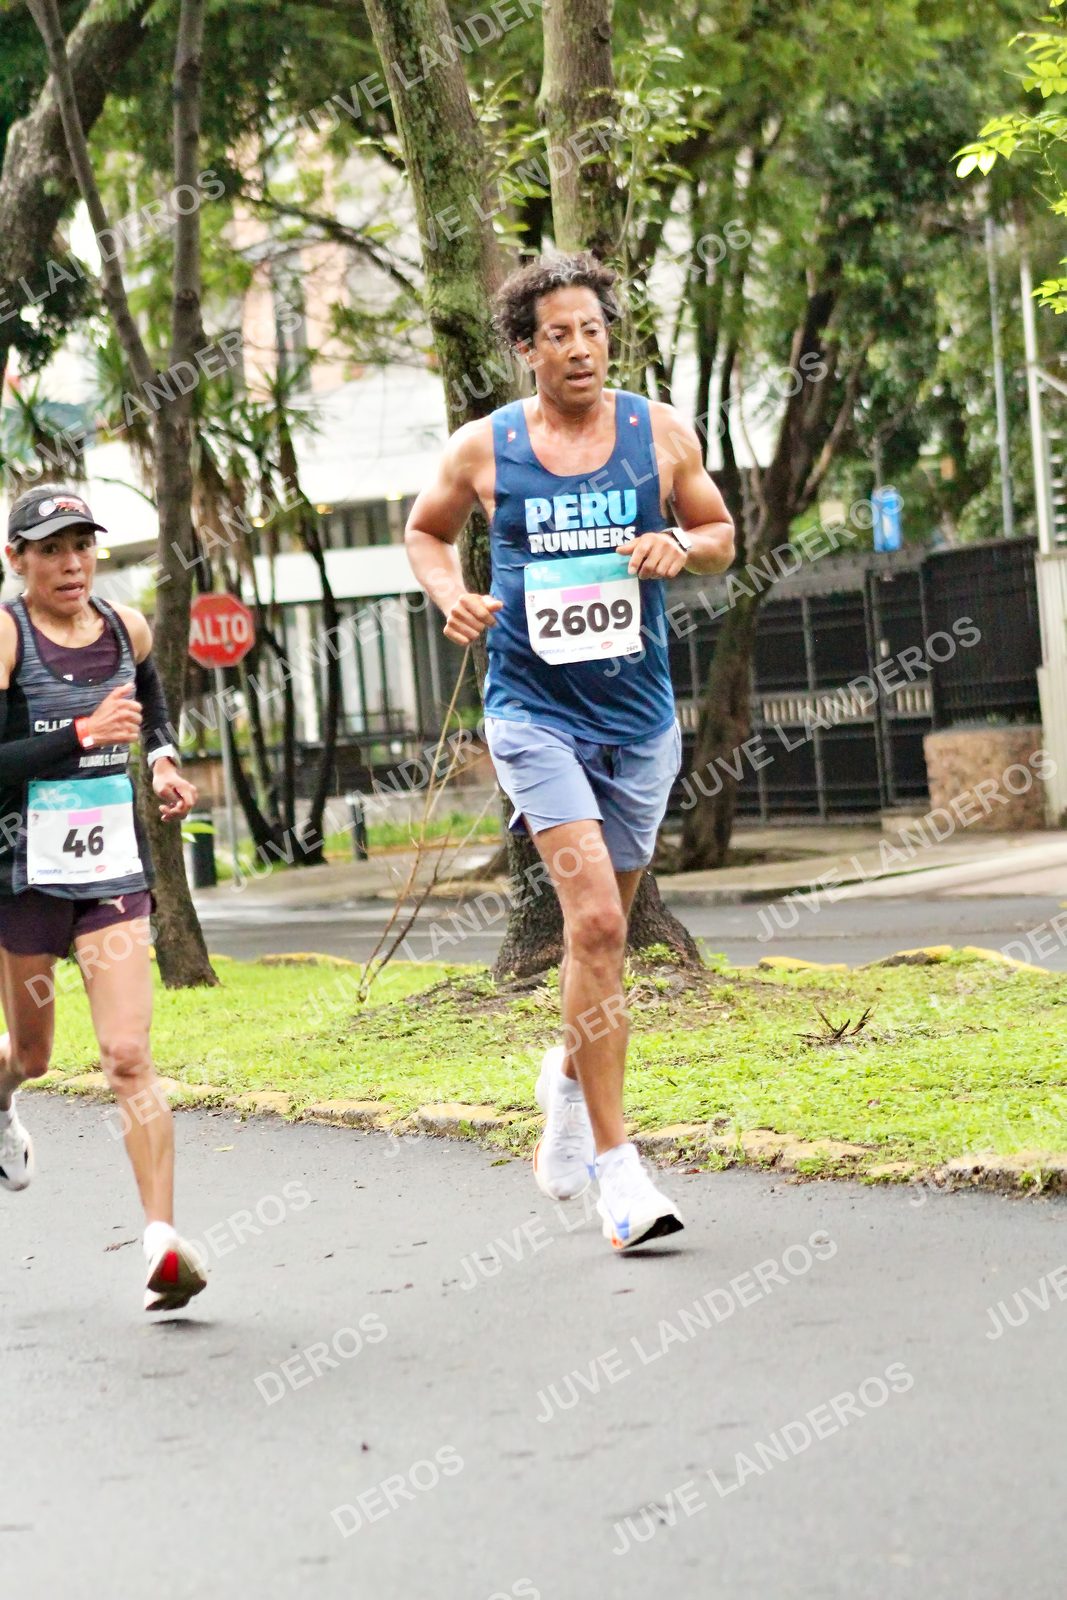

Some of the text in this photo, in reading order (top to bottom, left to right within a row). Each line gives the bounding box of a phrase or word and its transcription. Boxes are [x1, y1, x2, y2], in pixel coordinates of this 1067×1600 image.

[525, 489, 637, 533] PERU
[528, 526, 636, 553] RUNNERS
[189, 613, 249, 647] ALTO
[535, 599, 633, 639] 2609
[62, 826, 104, 858] 46
